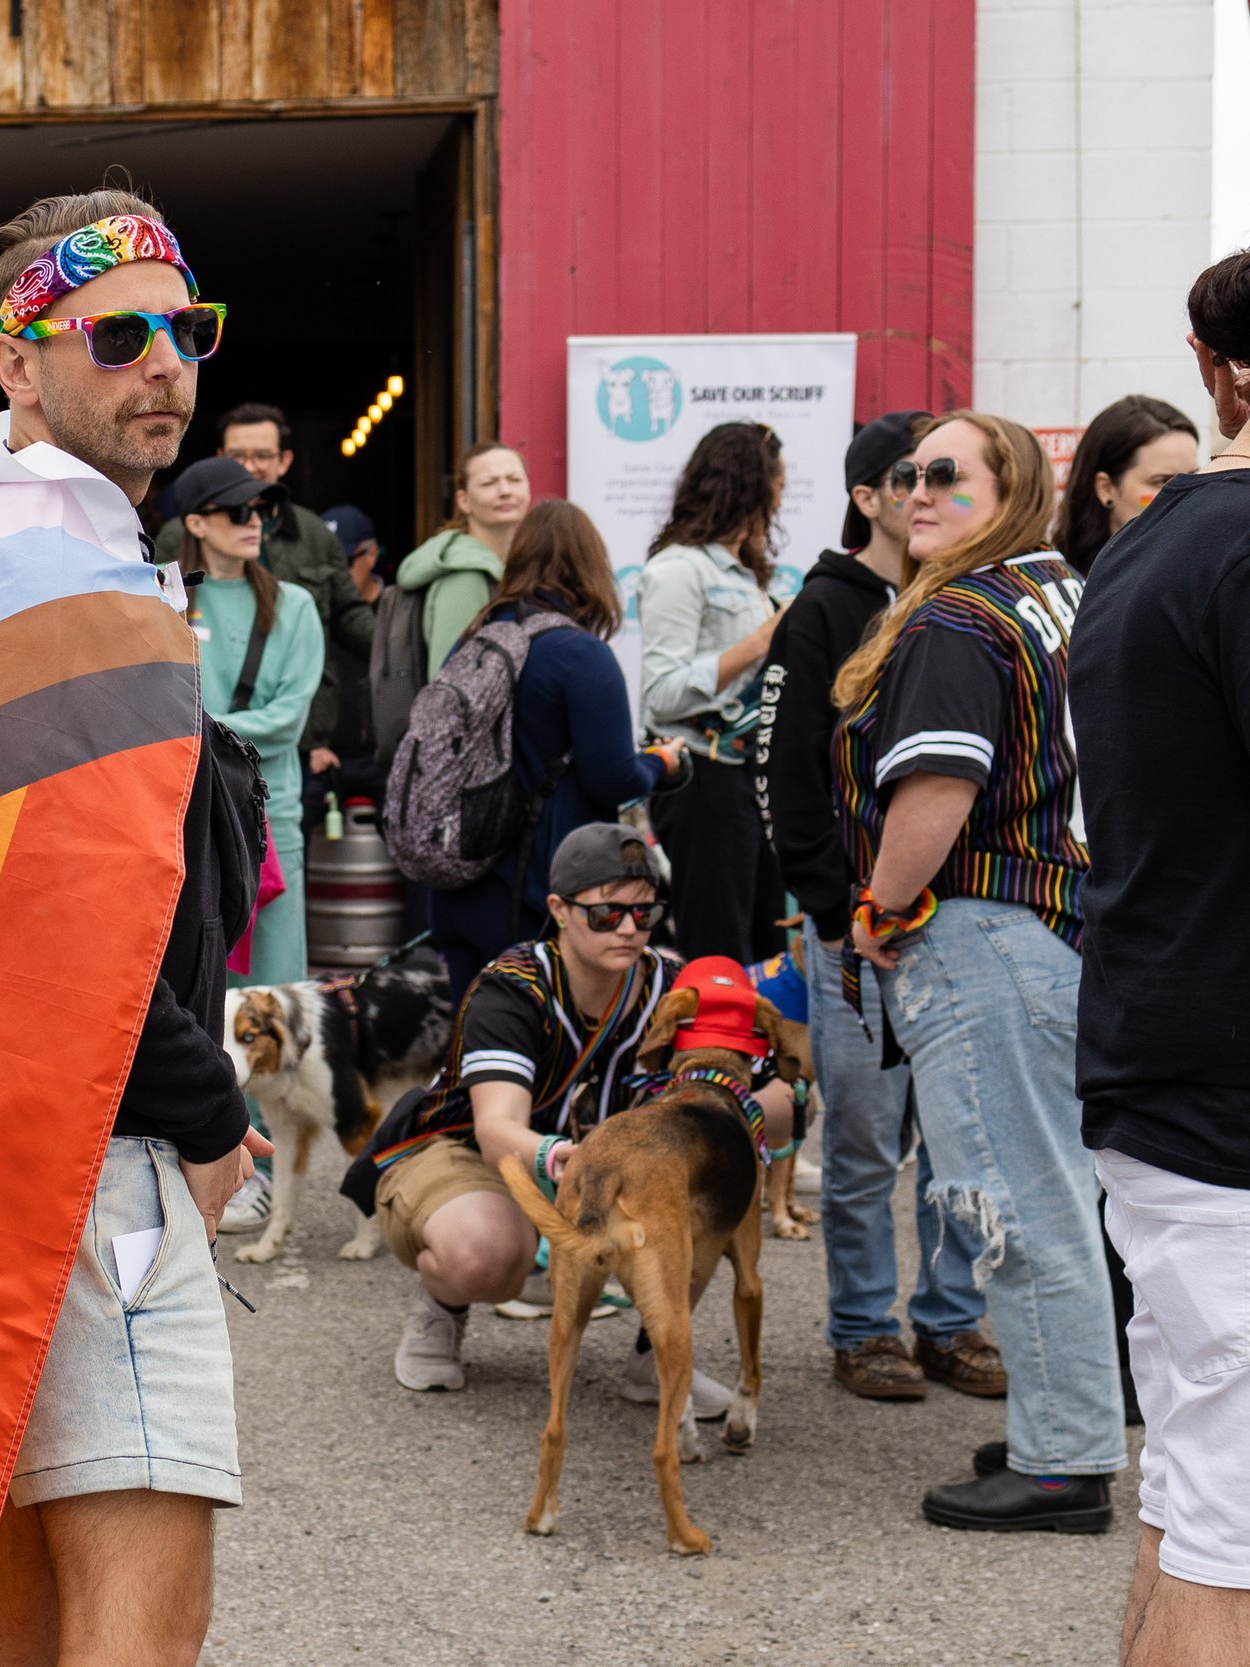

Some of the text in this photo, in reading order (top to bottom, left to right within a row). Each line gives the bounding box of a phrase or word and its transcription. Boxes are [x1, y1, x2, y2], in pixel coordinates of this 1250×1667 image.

[691, 385, 825, 402] SAVE OUR SCRUFF
